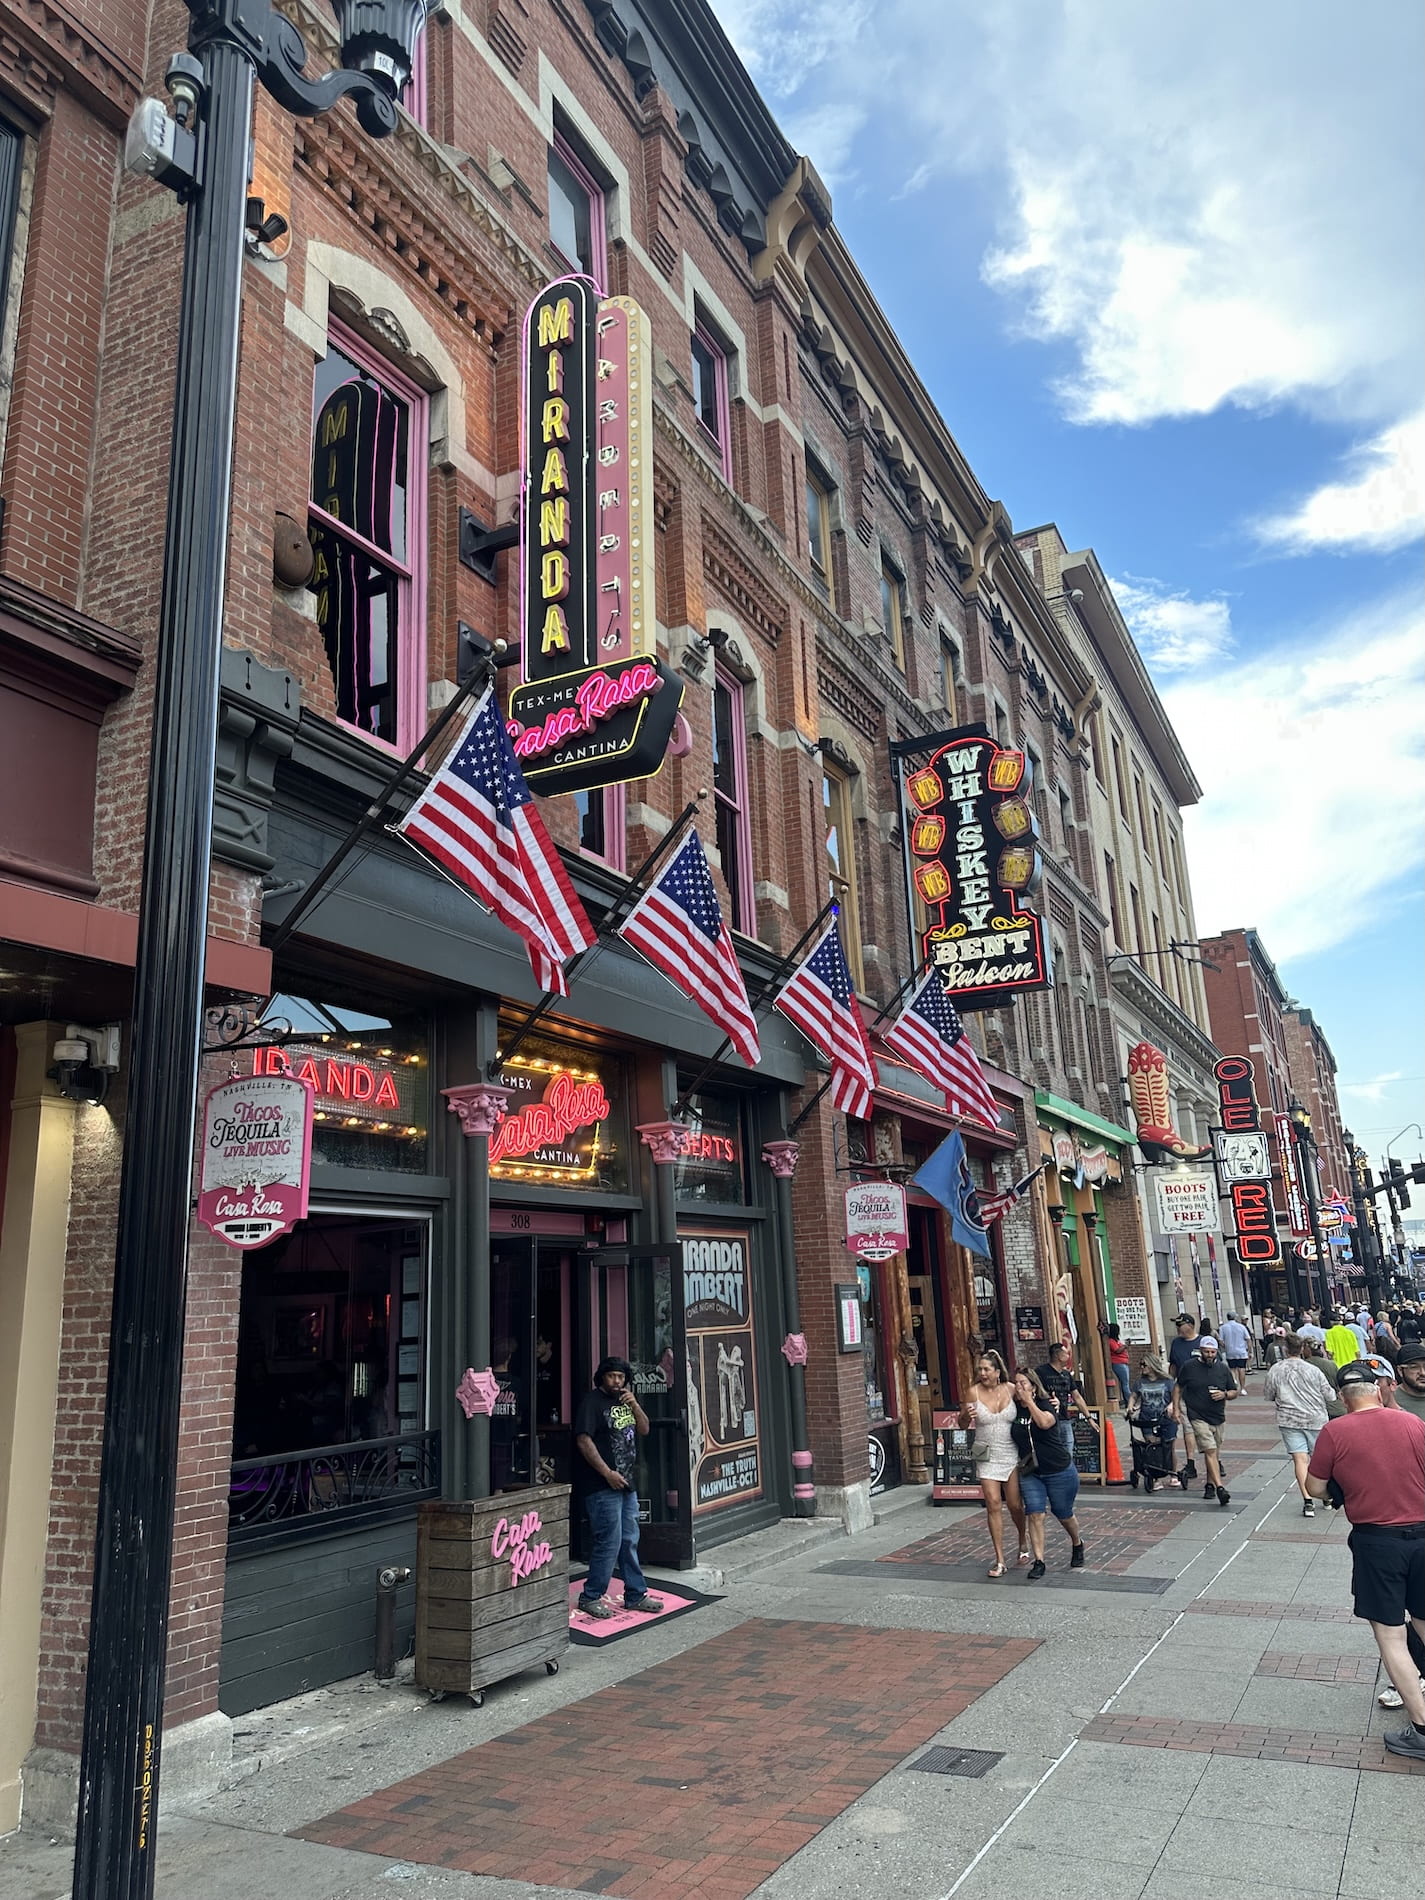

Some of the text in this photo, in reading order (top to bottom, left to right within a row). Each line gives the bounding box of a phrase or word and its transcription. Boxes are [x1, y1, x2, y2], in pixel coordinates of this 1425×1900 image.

[538, 297, 575, 655] MIRANDA
[598, 316, 621, 650] LAMBERT'S
[575, 664, 660, 730] Rosa
[554, 737, 629, 764] CANTINA
[994, 759, 1018, 785] WB
[915, 776, 940, 803] WB
[918, 824, 940, 848] WB
[943, 745, 994, 932] WHISKEY
[922, 870, 948, 898] WB
[933, 930, 1030, 965] BENT
[940, 959, 1034, 991] Saloon
[252, 1046, 399, 1109] IRANDA
[544, 1072, 610, 1144] Rosa
[1216, 1060, 1255, 1130] OLE
[234, 1101, 284, 1123] TACOS,
[211, 1117, 280, 1148] TEQUILA
[223, 1140, 291, 1157] LIVE MUSIC
[533, 1149, 581, 1164] CANTINA
[1165, 1183, 1206, 1194] BOOTS
[215, 1194, 284, 1216] Casa Rosa
[849, 1201, 890, 1216] TEQUILA
[871, 1212, 897, 1220] MUSIC
[1174, 1211, 1206, 1221] FREE
[511, 1214, 530, 1228] 308
[1233, 1184, 1276, 1260] RED
[857, 1236, 898, 1247] Casa Rosa
[683, 1240, 743, 1271] IRANDA
[684, 1272, 744, 1318] MBERT
[687, 1302, 730, 1318] ONE NIGHT ONLY
[721, 1455, 756, 1477] THE TRUTH
[491, 1511, 542, 1558] Casa
[510, 1541, 553, 1587] Rosa
